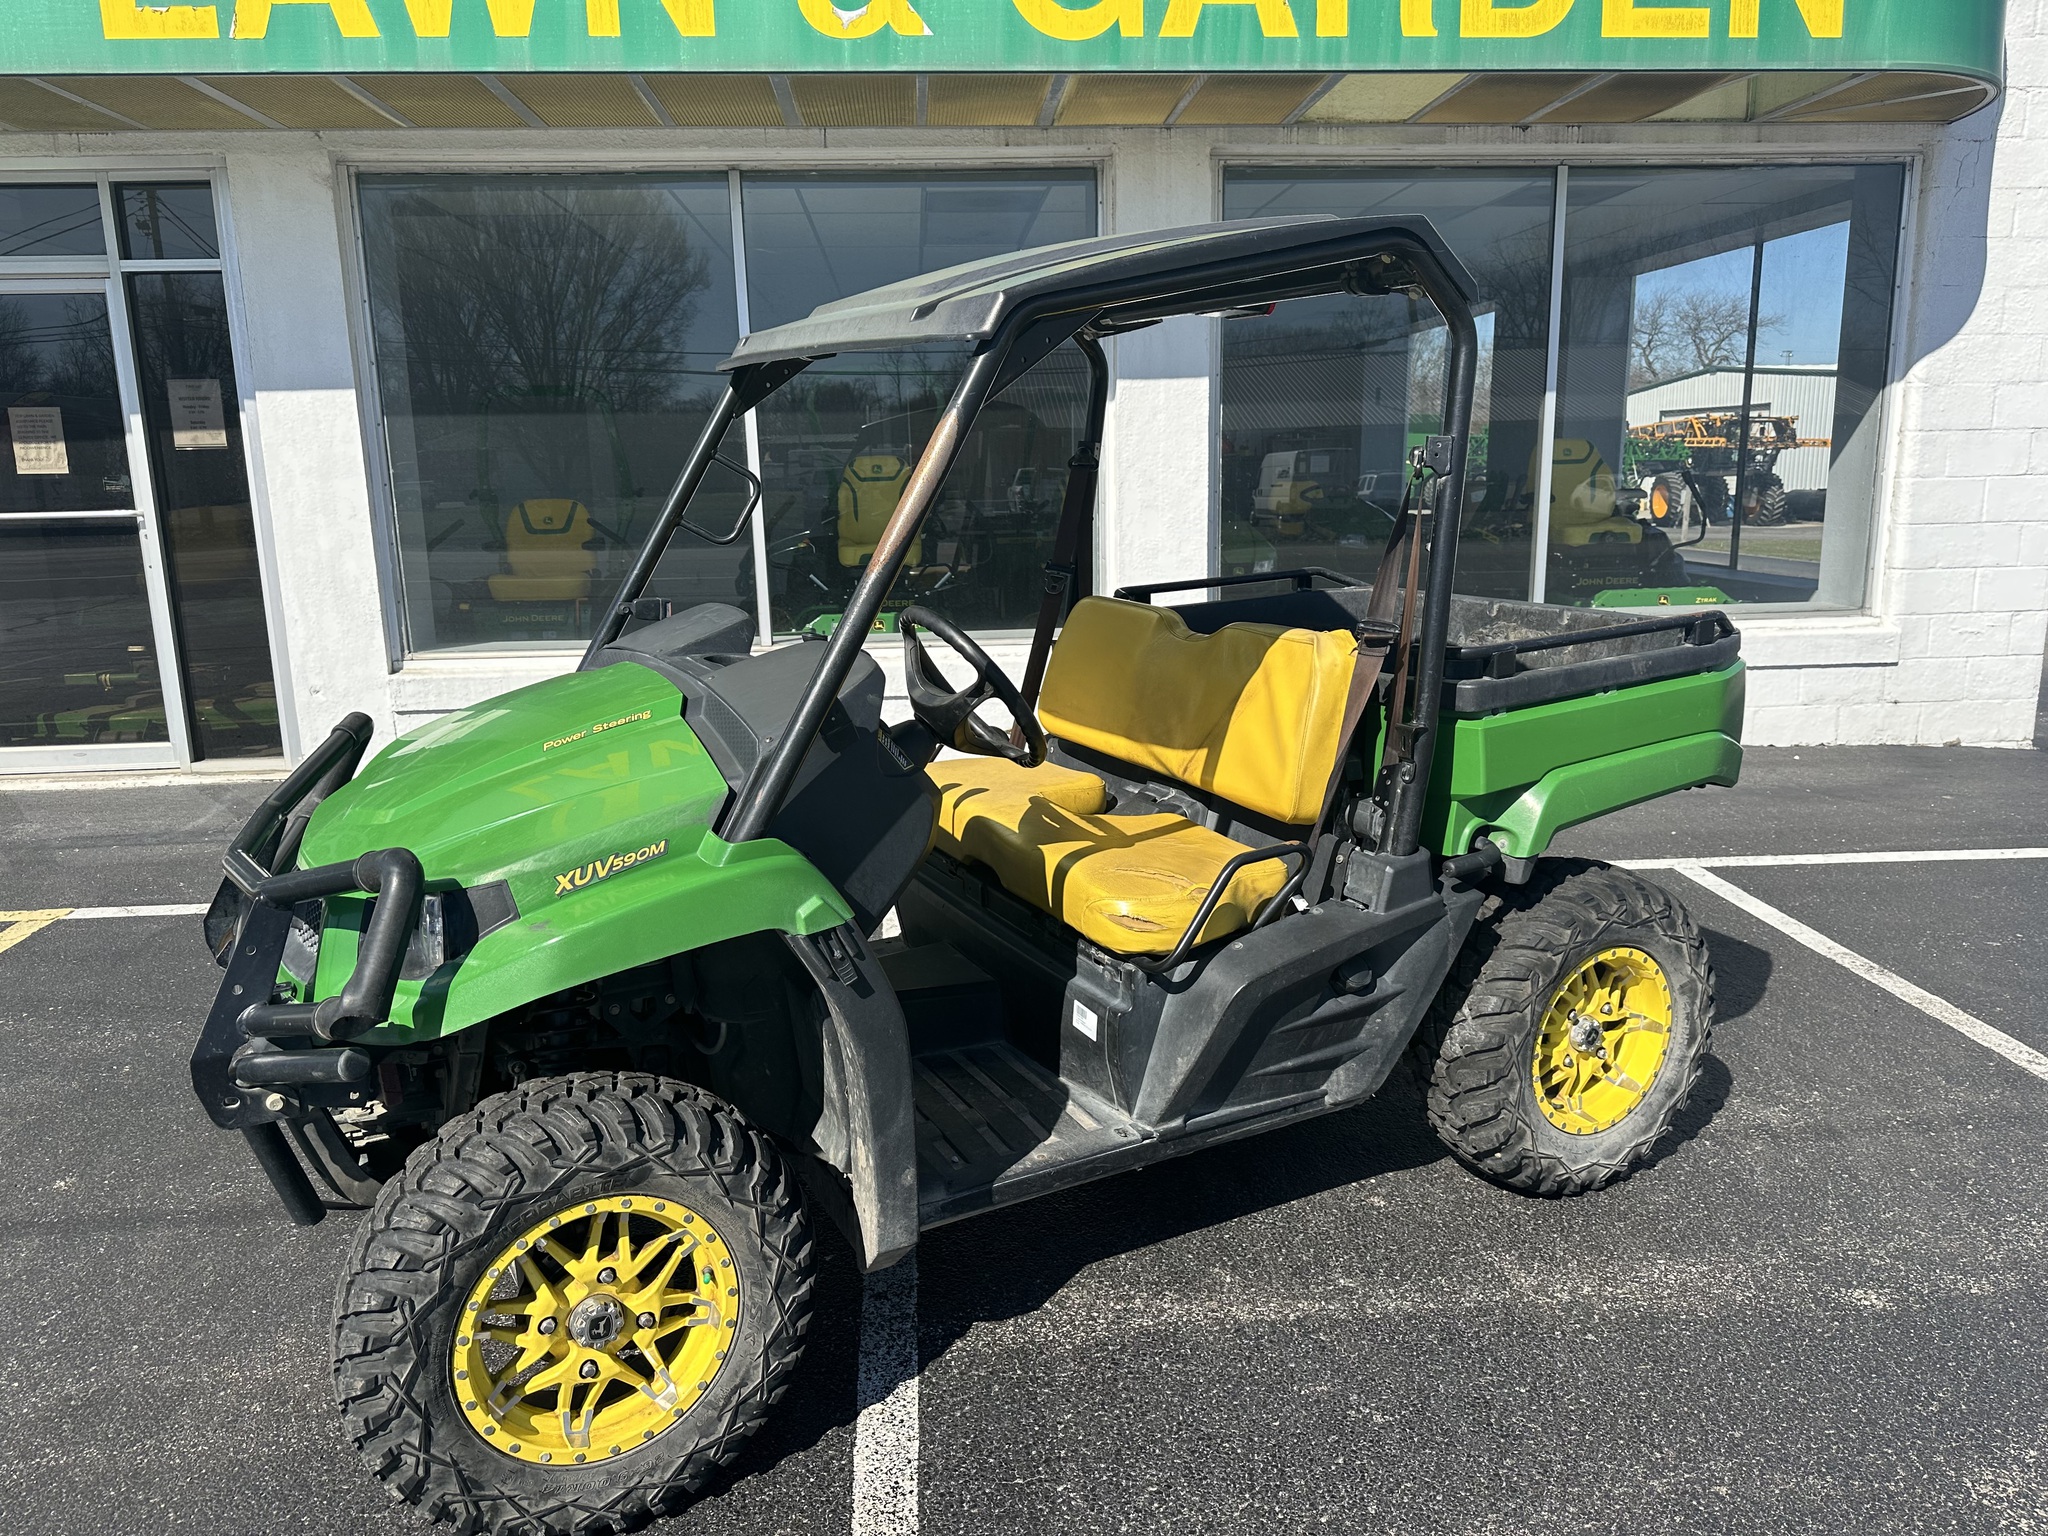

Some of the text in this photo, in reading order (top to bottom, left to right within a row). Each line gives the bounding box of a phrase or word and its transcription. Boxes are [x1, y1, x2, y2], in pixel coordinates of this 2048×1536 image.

[1576, 576, 1639, 586] JOHN DEERE
[502, 614, 565, 623] JOHN DEERE
[543, 709, 652, 752] Power Steering
[555, 840, 666, 895] XUV590M
